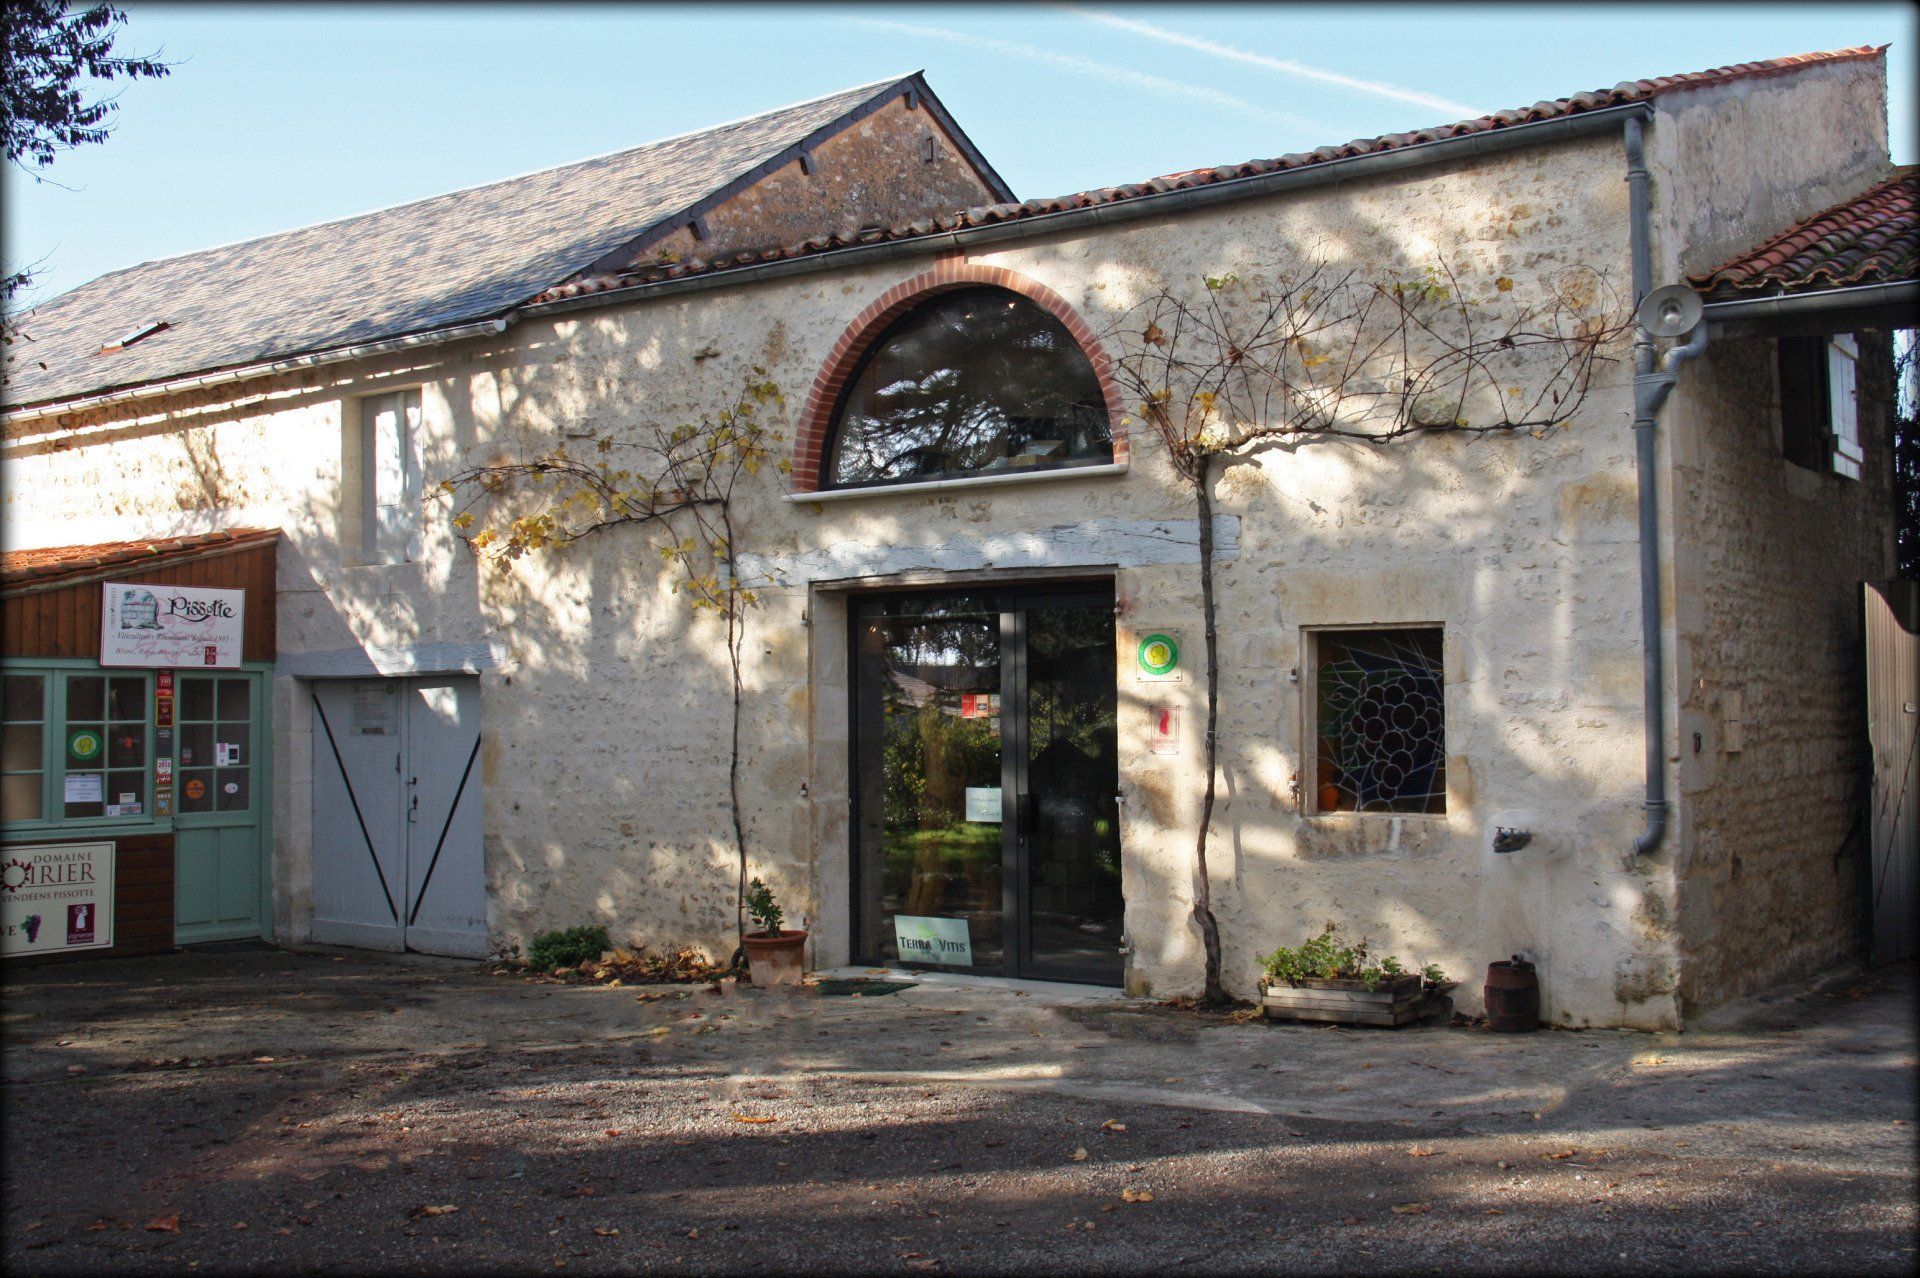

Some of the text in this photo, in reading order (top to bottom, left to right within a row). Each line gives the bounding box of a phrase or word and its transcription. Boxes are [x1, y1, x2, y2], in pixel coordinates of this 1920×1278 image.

[164, 597, 237, 622] Pissotte
[33, 852, 93, 864] DOMAINE
[53, 888, 95, 899] PISSOTTE
[899, 936, 965, 953] TERRA VITIS
